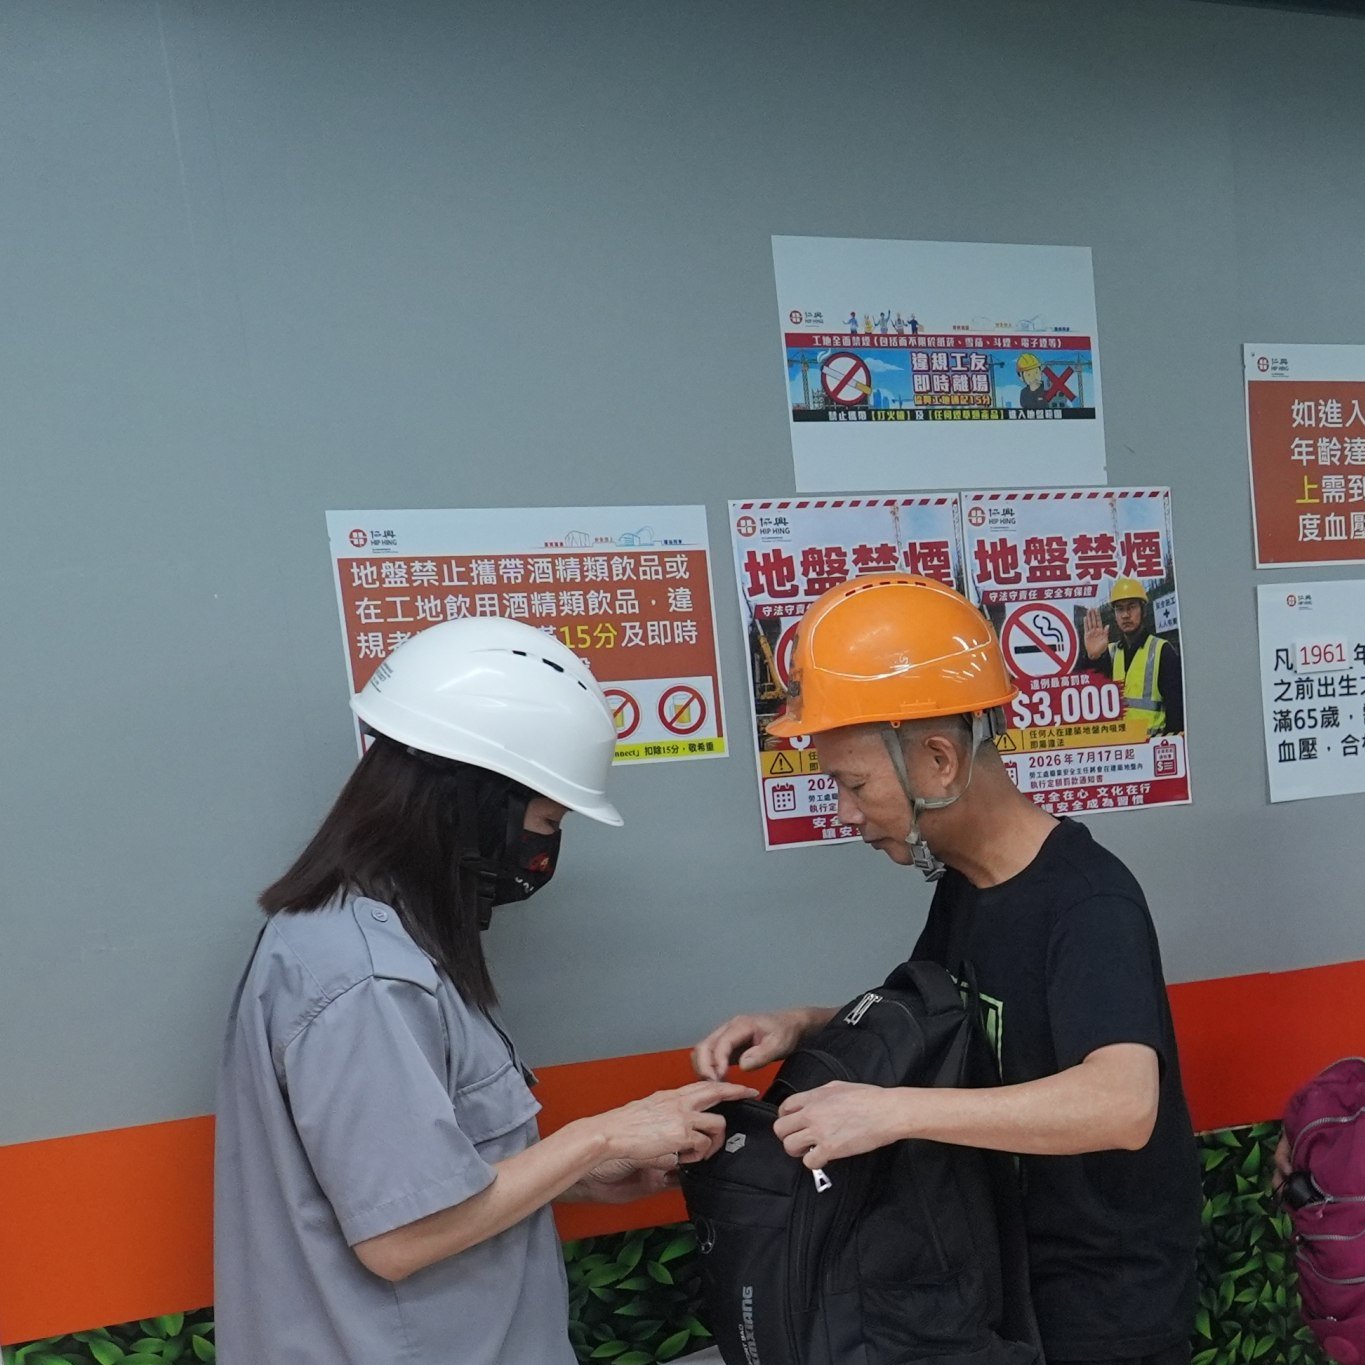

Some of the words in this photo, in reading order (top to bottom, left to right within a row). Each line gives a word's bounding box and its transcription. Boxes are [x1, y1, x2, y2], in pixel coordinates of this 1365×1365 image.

[911, 351, 988, 372] 違規工友
[913, 374, 990, 393] 即時離場
[772, 527, 790, 535] HING
[974, 531, 1165, 586] 地盤禁煙
[350, 554, 690, 589] 地盤禁止攜帶酒精類飲品或
[355, 586, 693, 624] 在工地飲用酒精類飲品，違
[988, 590, 1039, 602] 守法守責任
[1044, 586, 1093, 599] 安全有保證
[762, 603, 812, 617] 守法守責
[541, 619, 699, 650] 15分及即時
[1030, 674, 1090, 690] 違例最高罰款
[1011, 683, 1121, 730] $3,000
[1032, 788, 1089, 805] 安全在心
[1096, 782, 1151, 798] 文化在行
